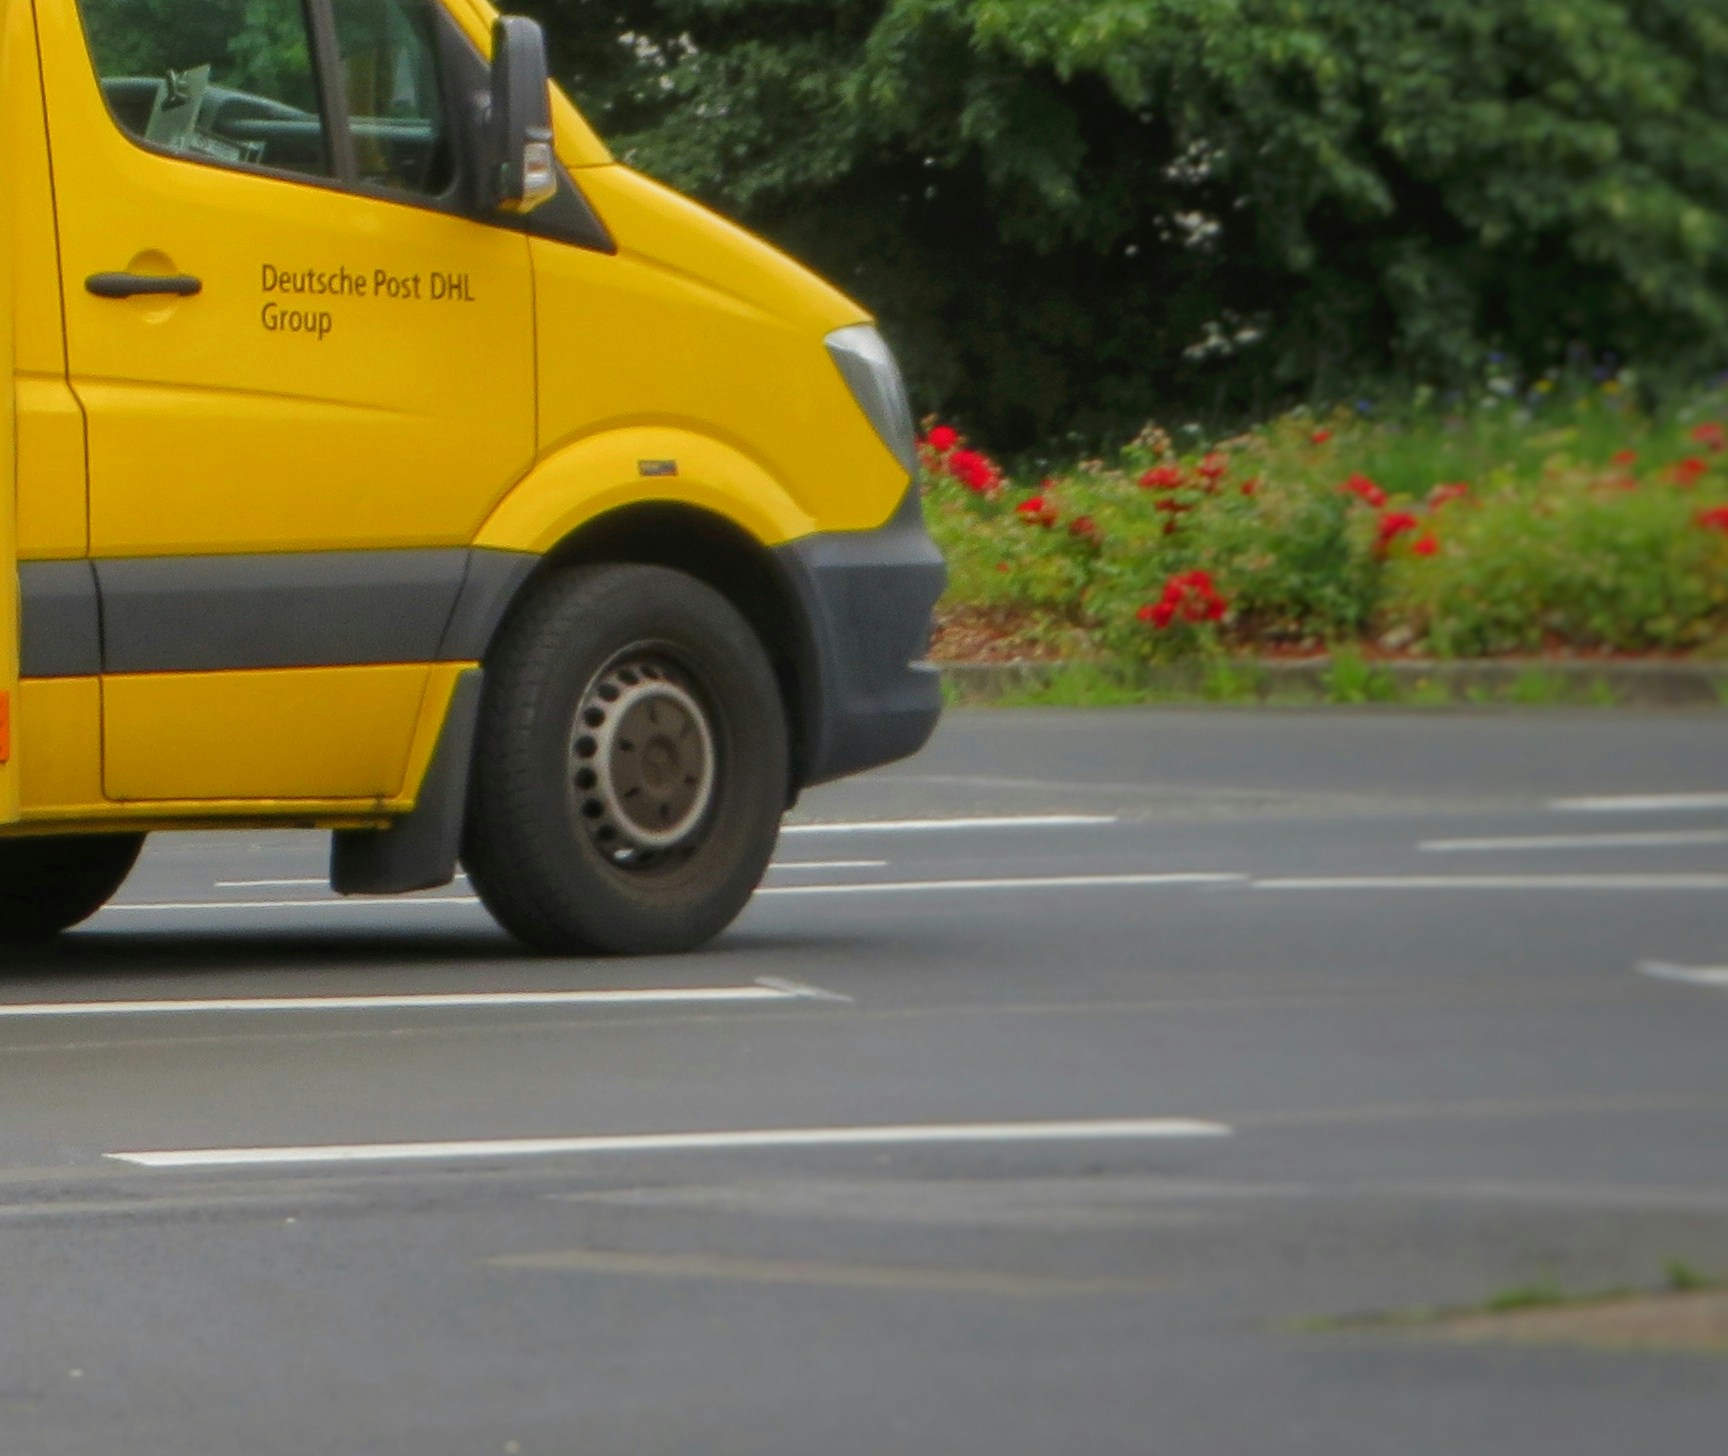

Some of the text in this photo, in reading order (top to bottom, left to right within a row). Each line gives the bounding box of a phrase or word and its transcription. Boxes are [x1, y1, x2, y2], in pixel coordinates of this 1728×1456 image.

[261, 263, 476, 303] Deutsche Post DHL
[261, 301, 333, 341] Group
